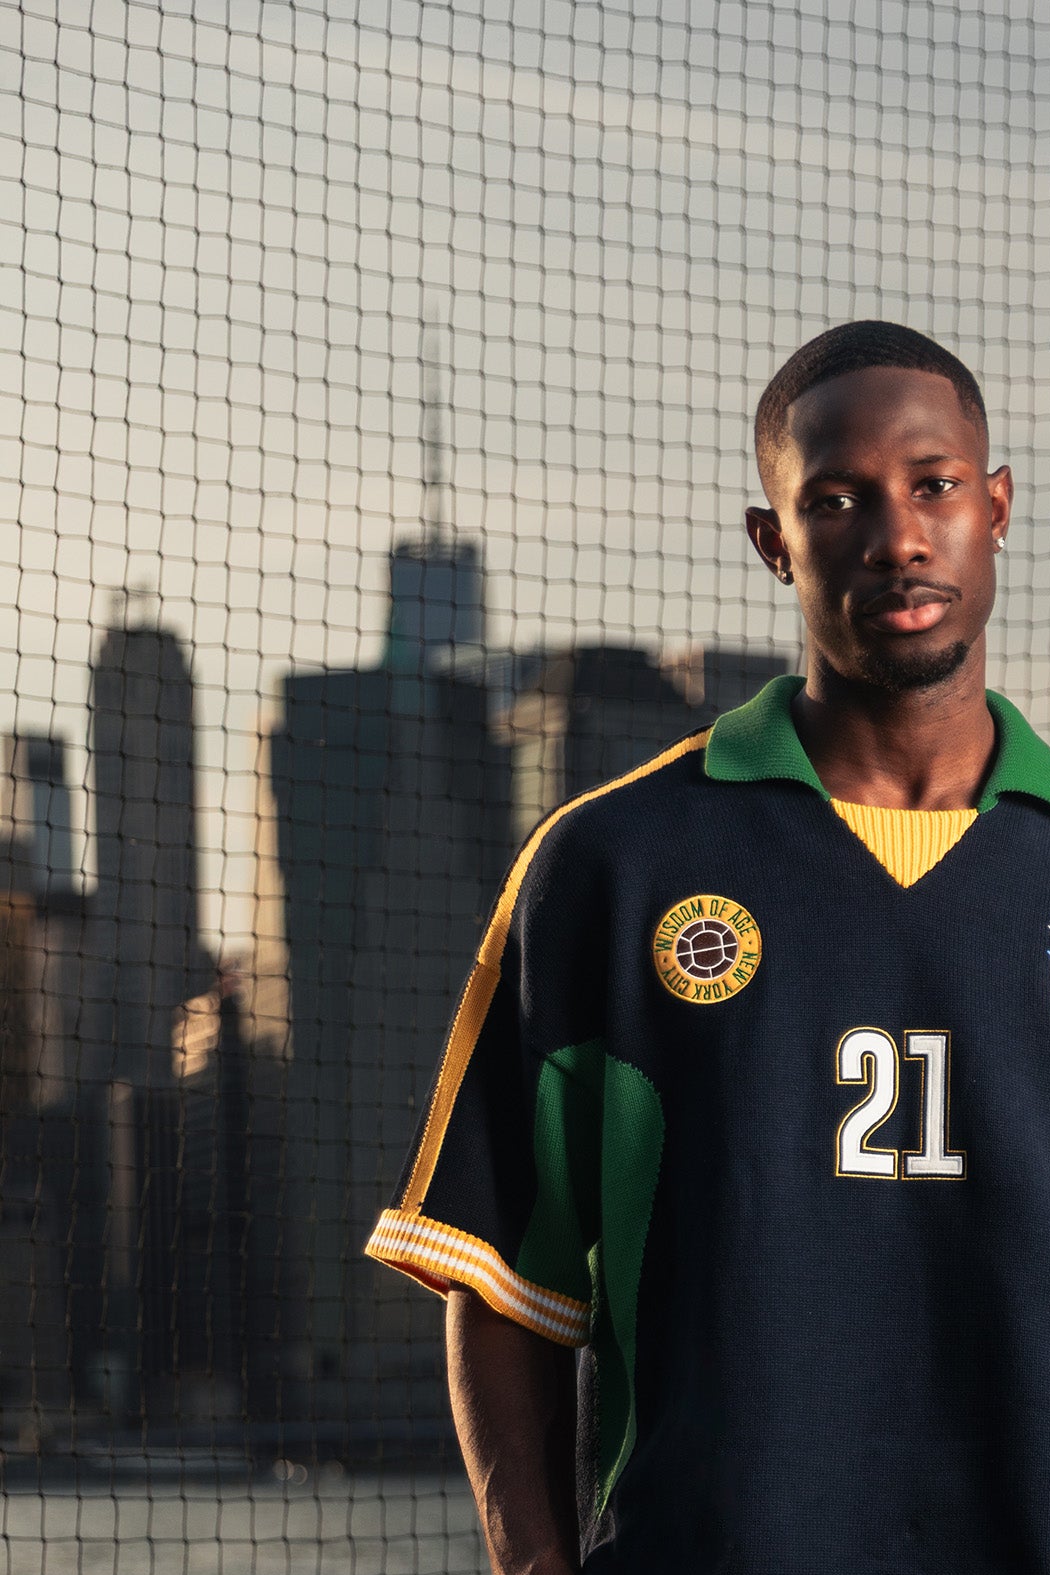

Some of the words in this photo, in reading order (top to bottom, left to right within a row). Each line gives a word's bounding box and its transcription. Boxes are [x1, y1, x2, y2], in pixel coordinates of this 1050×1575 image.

[655, 898, 704, 952] WISDOM
[710, 899, 729, 917] OF
[728, 909, 757, 937] AGE
[662, 967, 691, 995] CITY
[732, 951, 758, 985] NEW
[692, 980, 733, 1000] YORK
[836, 1026, 967, 1180] 21
